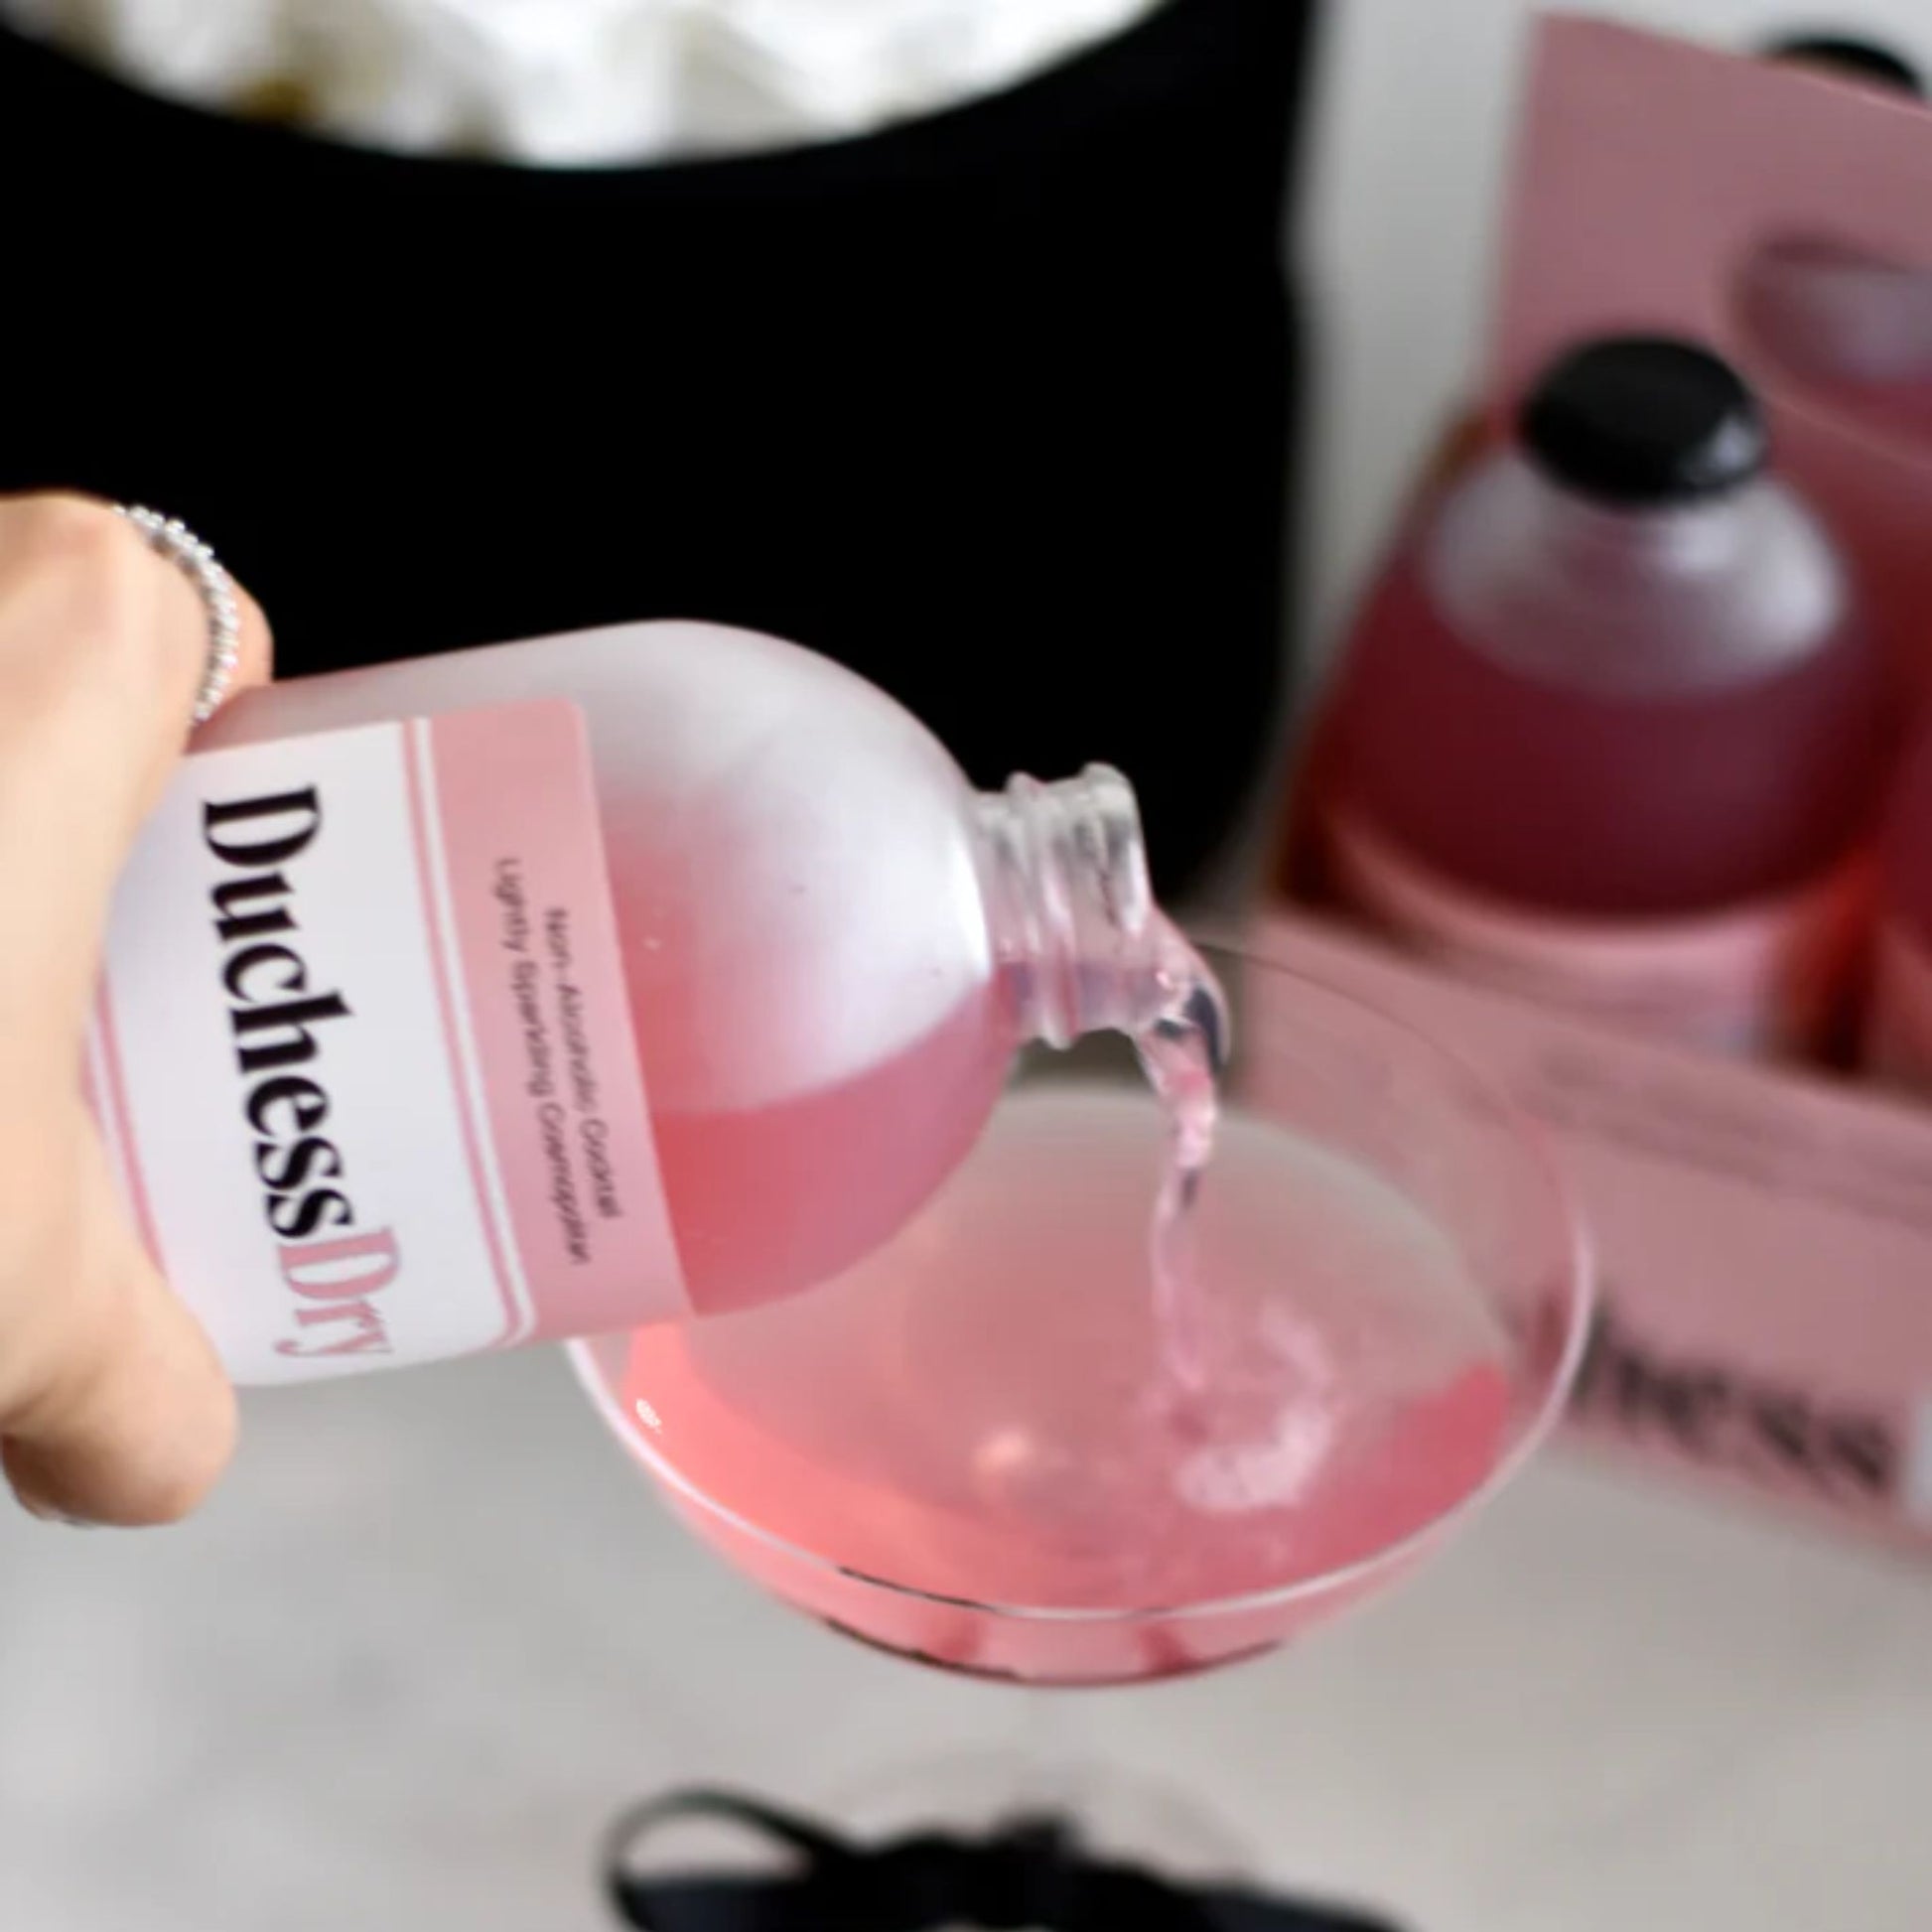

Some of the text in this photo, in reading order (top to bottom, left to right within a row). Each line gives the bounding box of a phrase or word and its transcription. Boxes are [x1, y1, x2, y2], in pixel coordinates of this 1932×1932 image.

[491, 857, 592, 1266] Lightly Sparkling Cosmopolitan
[544, 907, 622, 1220] Non-Alcoholic Cocktail
